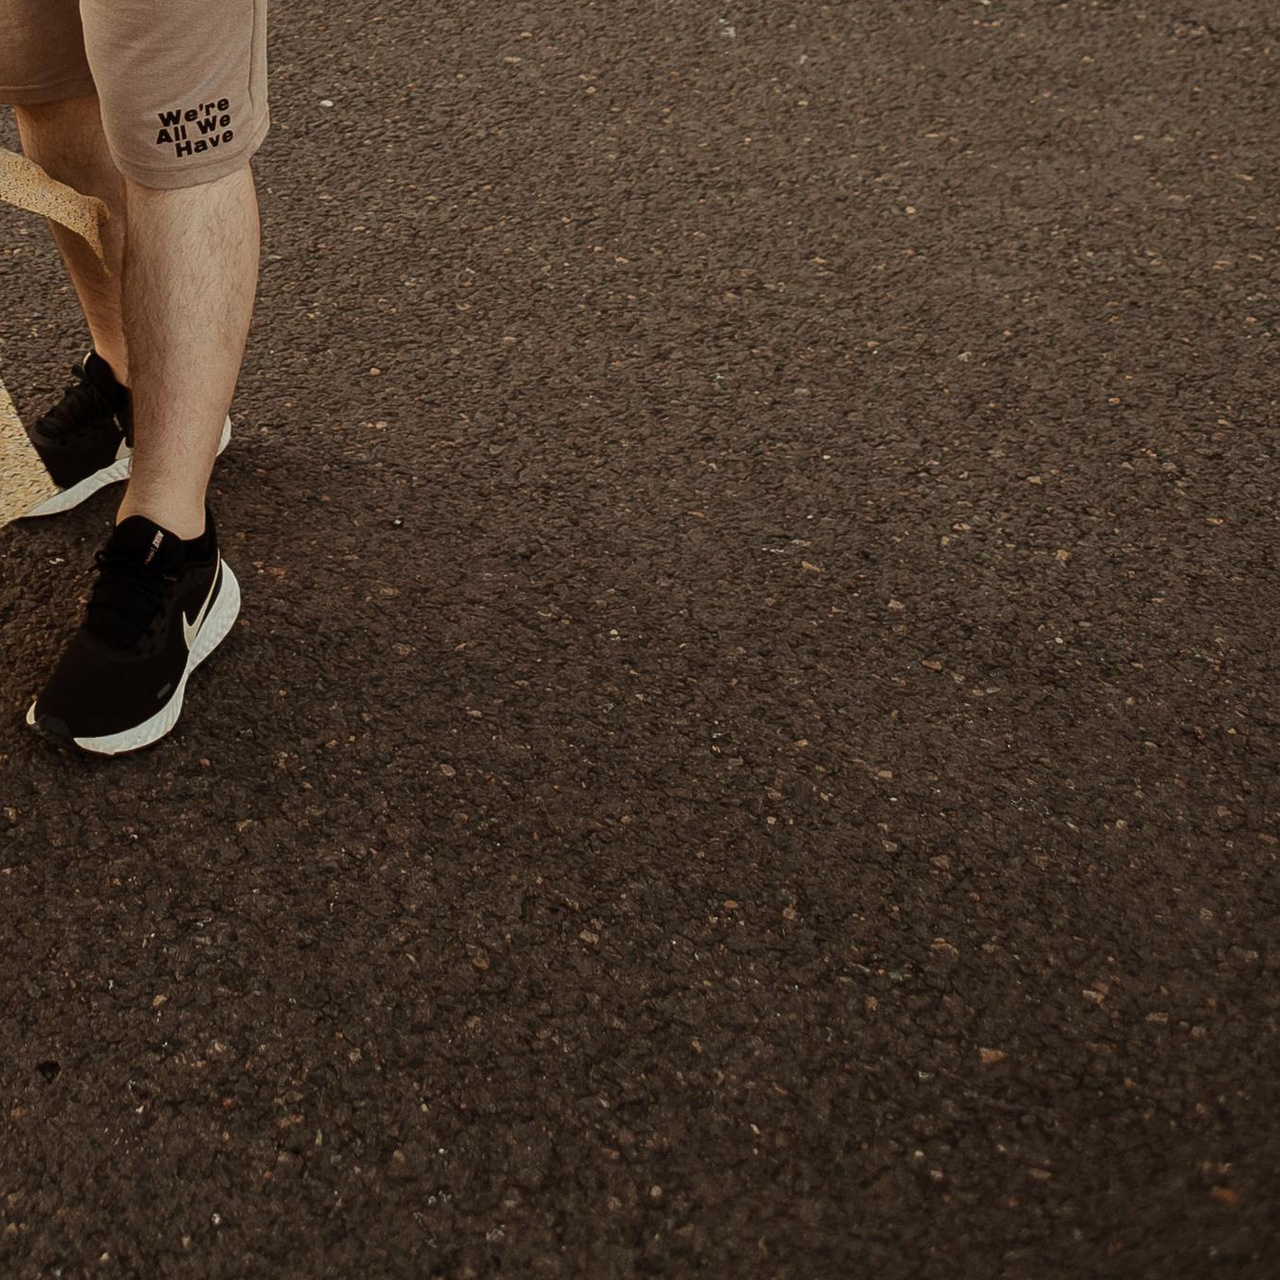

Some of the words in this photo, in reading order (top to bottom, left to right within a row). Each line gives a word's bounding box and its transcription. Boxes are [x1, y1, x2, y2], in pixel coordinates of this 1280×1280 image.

[158, 98, 229, 127] We're
[156, 125, 187, 144] All
[196, 114, 231, 134] We
[175, 130, 233, 157] Have
